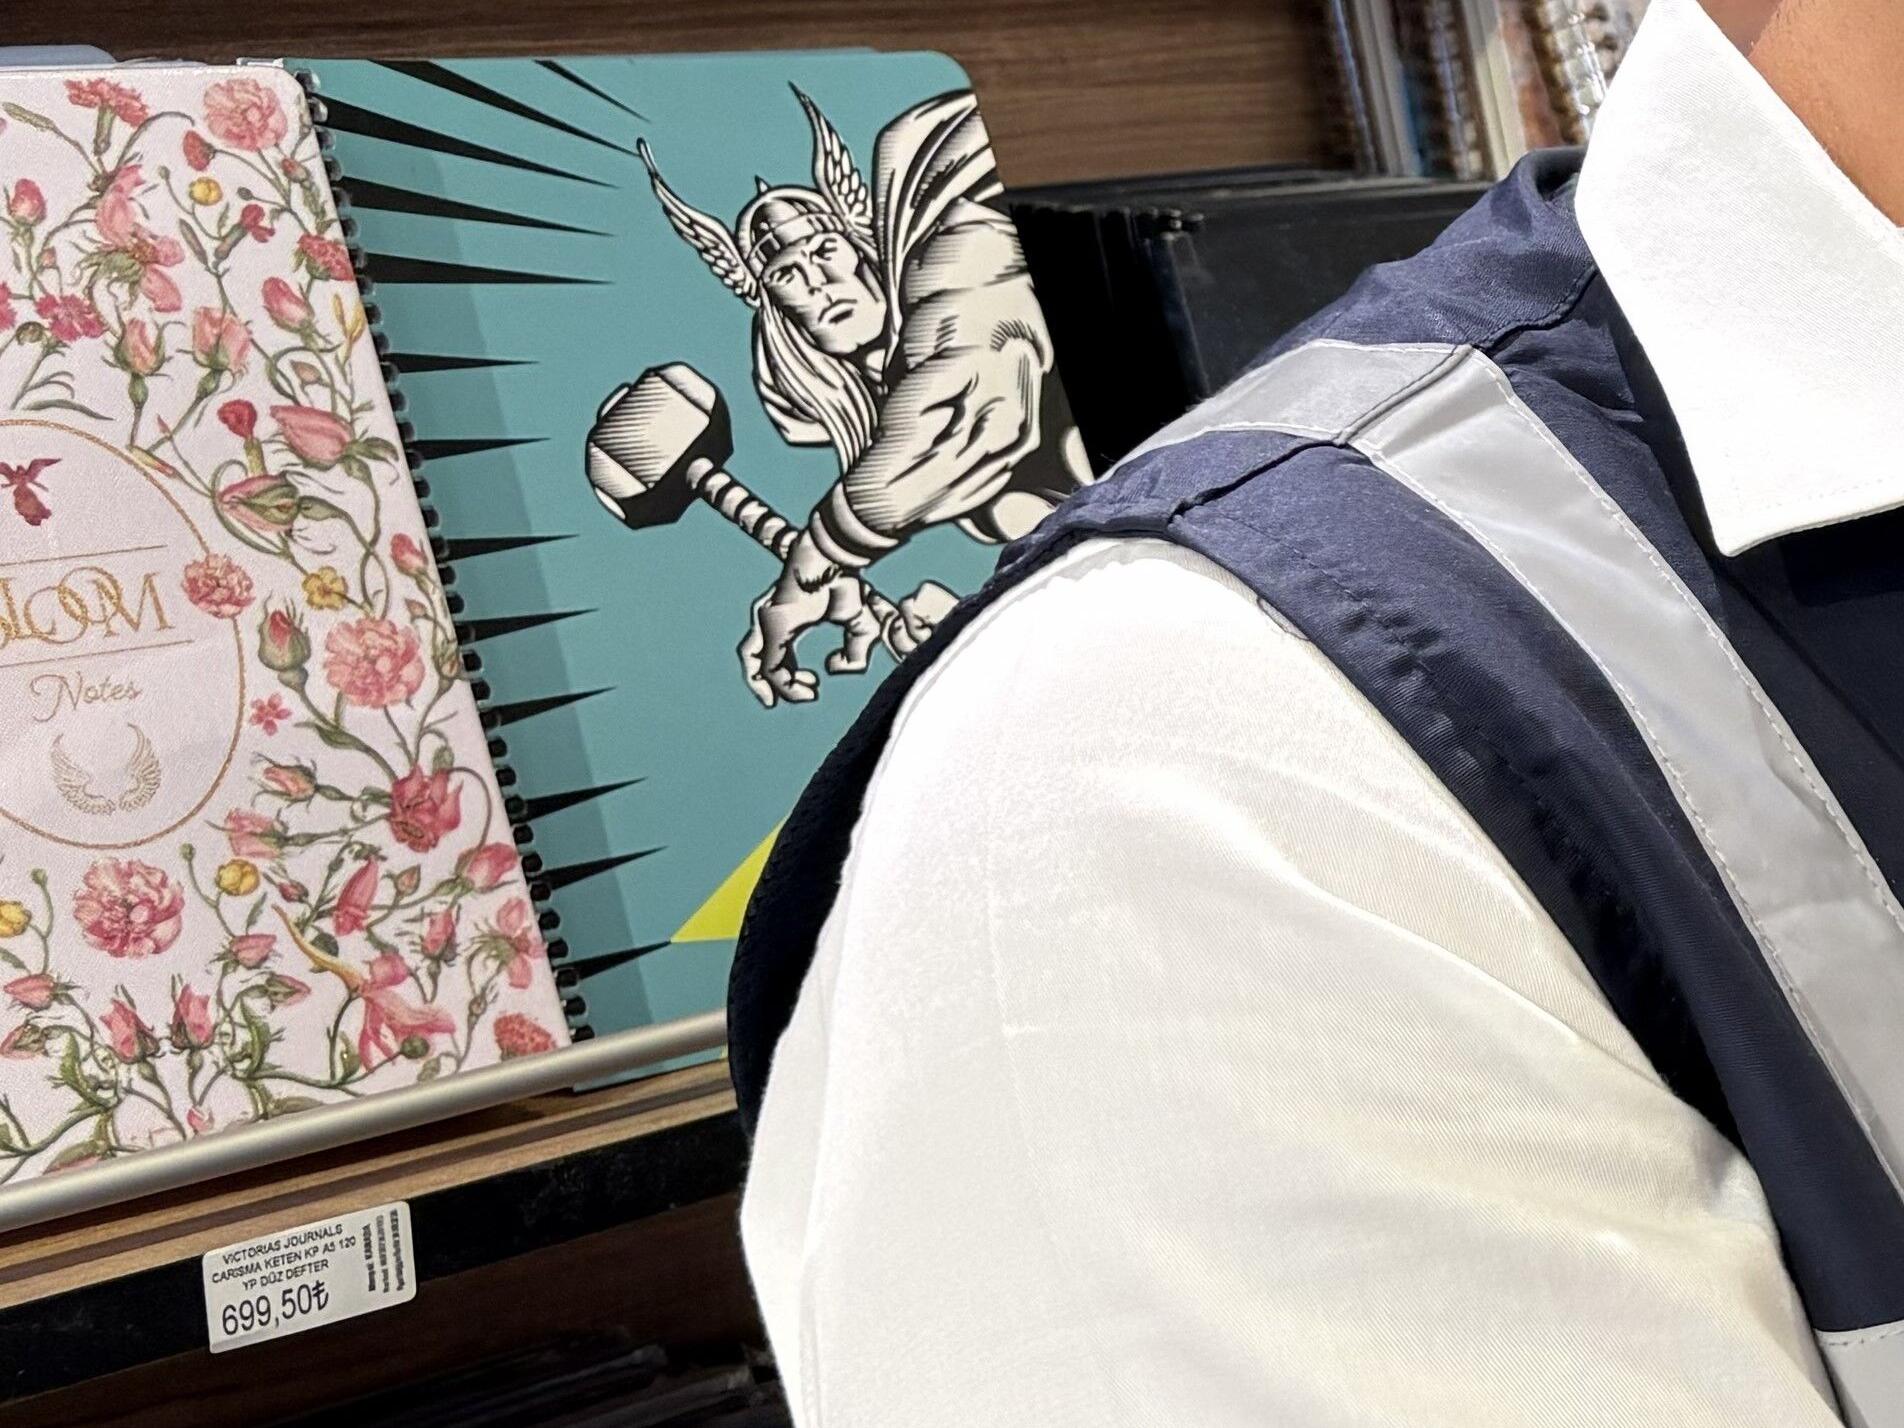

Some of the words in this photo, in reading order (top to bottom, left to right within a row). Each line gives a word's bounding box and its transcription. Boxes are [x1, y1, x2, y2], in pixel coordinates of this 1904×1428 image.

[30, 670, 141, 723] Notes
[222, 1238, 282, 1265] VICTORIAS
[283, 1223, 343, 1250] JOURNALS
[264, 1252, 302, 1272] KETEN
[304, 1245, 320, 1260] KP
[338, 1236, 357, 1251] 120
[286, 1259, 329, 1281] DEFTER
[222, 1279, 330, 1336] 699,50₺
